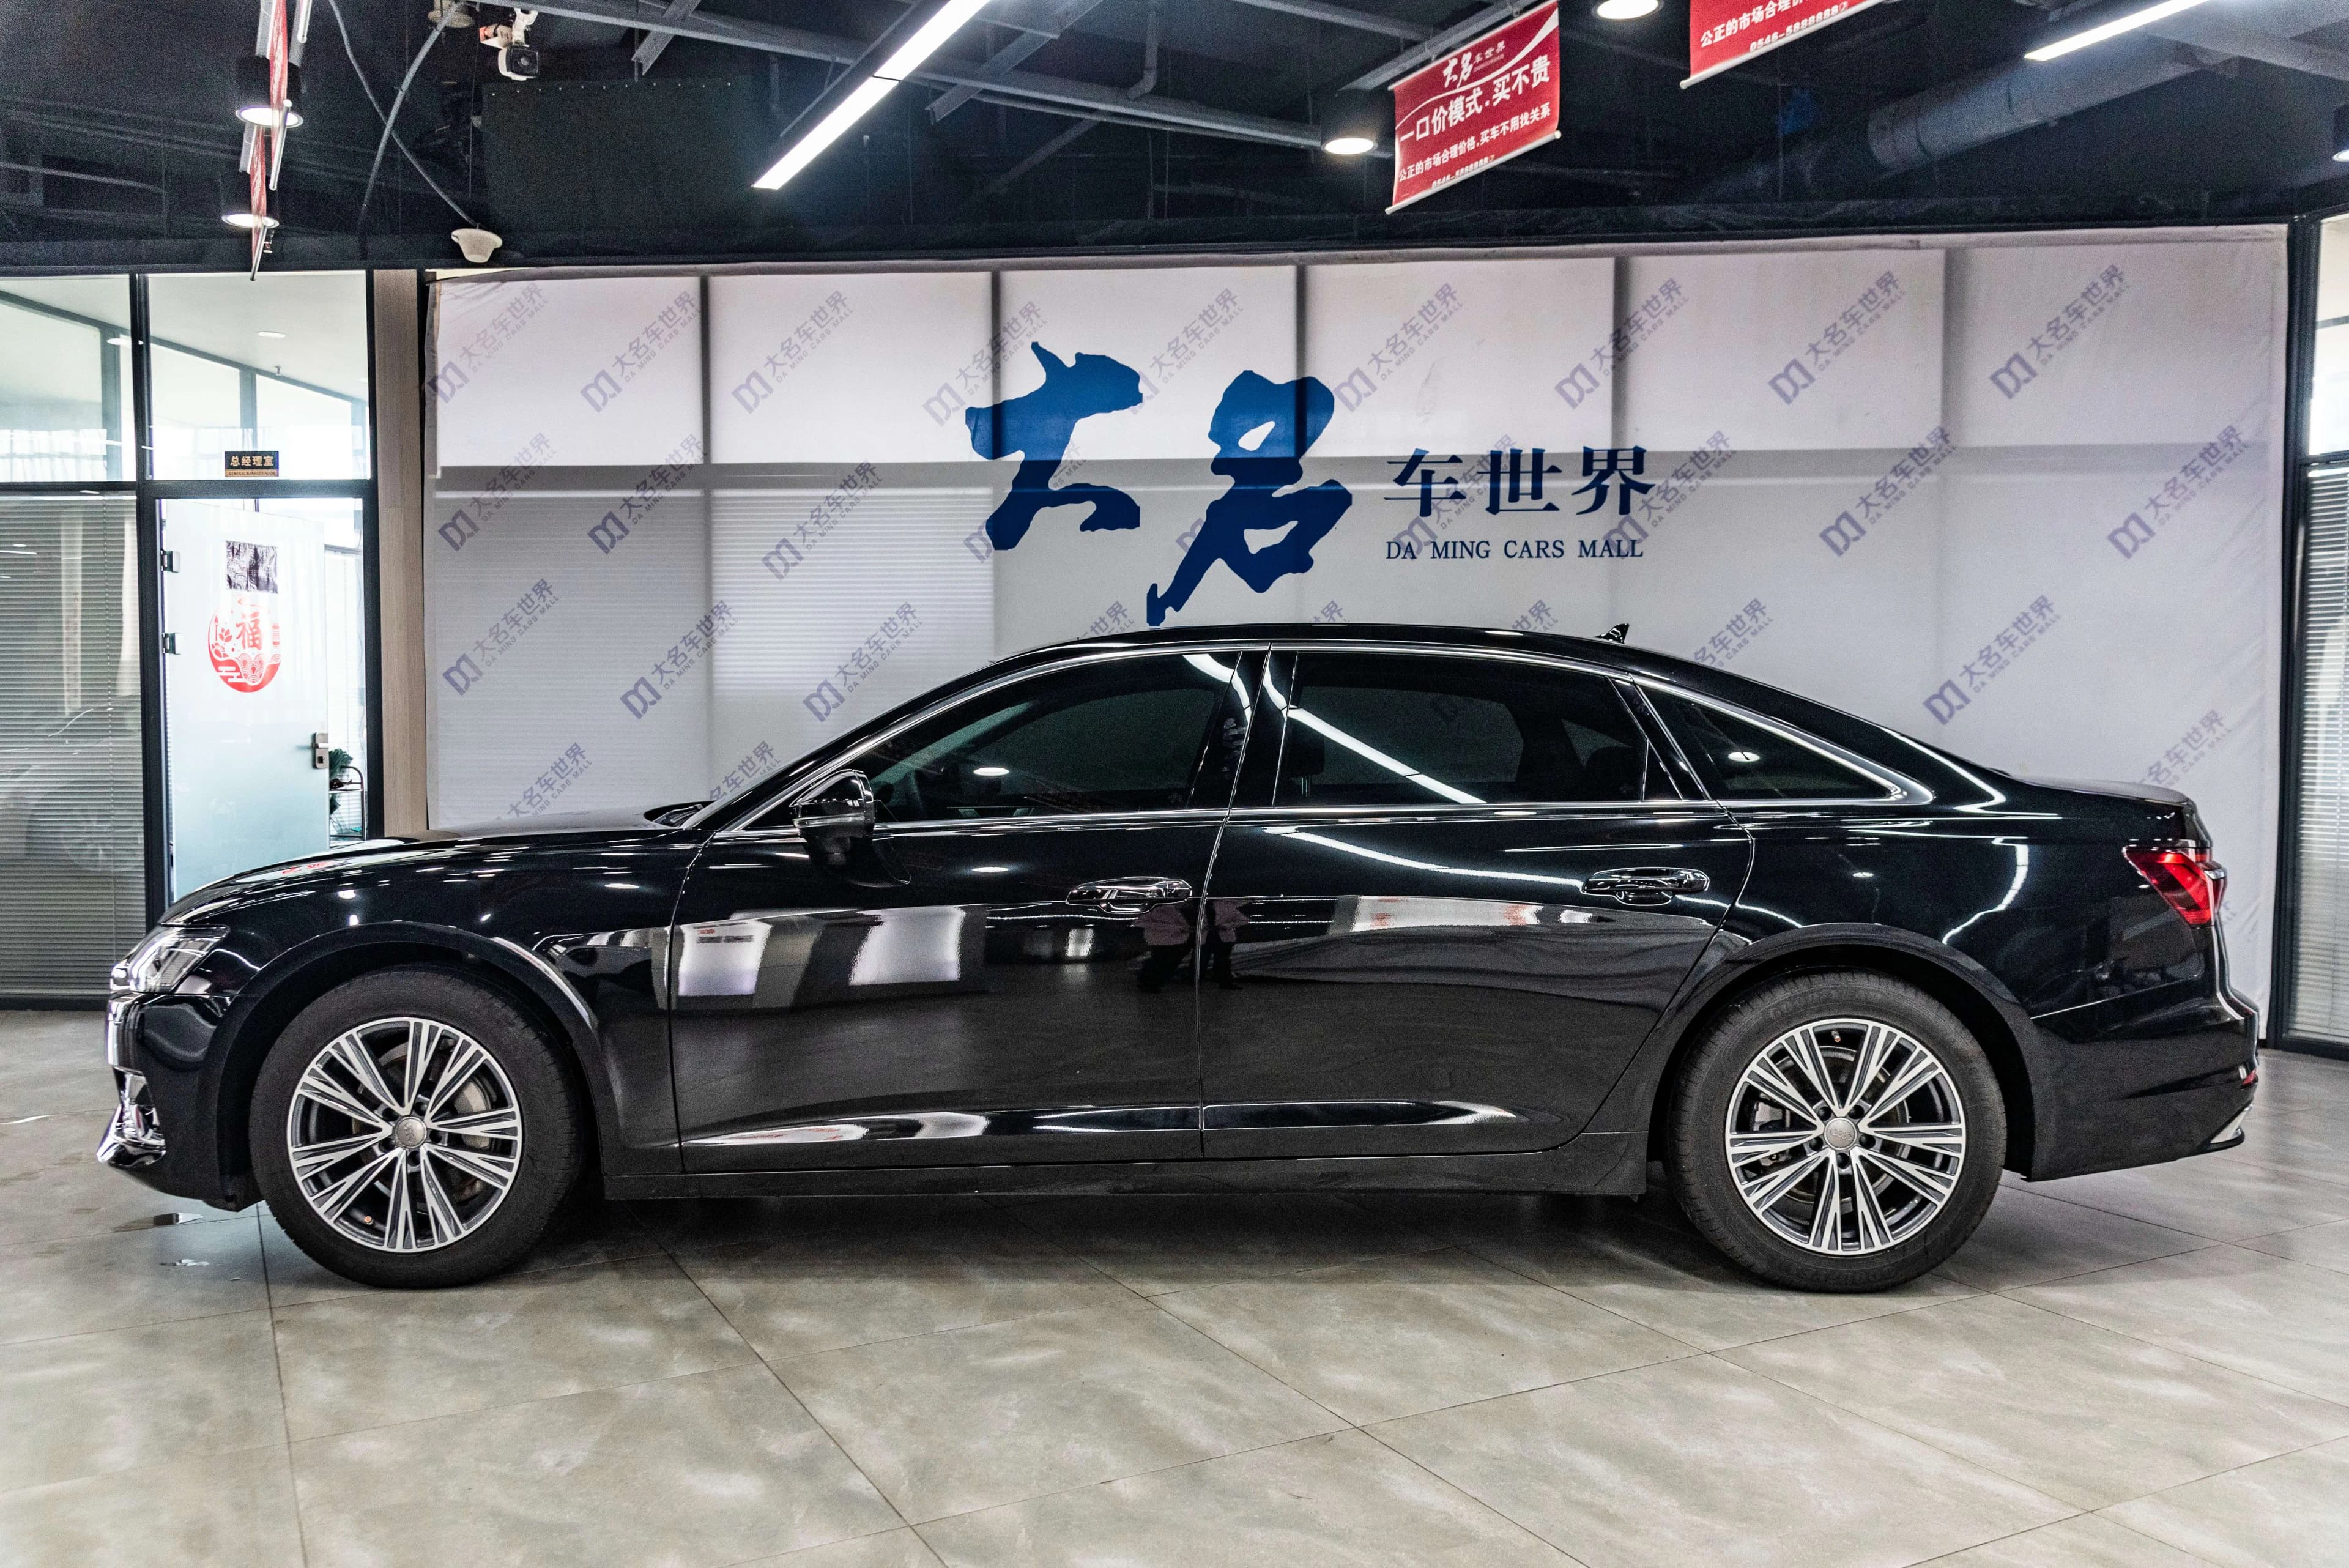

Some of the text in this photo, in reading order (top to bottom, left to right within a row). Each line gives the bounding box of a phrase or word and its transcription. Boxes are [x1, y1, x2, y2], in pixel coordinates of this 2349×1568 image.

[460, 283, 543, 367] 大名车世界
[612, 291, 695, 377] 大名车世界
[764, 290, 847, 377] 大名车世界
[956, 302, 1040, 390] 大名车世界
[1150, 288, 1237, 378] 大名车世界
[1368, 283, 1457, 375] 大名车世界
[1590, 278, 1681, 371] 大名车世界
[1805, 270, 1898, 365] 大名车世界
[2027, 264, 2123, 360] 大名车世界
[230, 455, 273, 466] 总经理室
[620, 434, 703, 519] 大名车世界
[793, 461, 876, 545] 大名车世界
[1384, 448, 1655, 517] 车世界
[1639, 431, 1730, 521] 大名车世界
[1855, 427, 1950, 519] 大名车世界
[2145, 425, 2242, 519] 大名车世界
[1386, 540, 1643, 559] DA MING CARS MALL
[235, 611, 262, 650] 福
[473, 578, 552, 661] 大名车世界
[651, 600, 732, 685] 大名车世界
[835, 602, 916, 687] 大名车世界
[1116, 619, 1134, 633] ALL
[1538, 618, 1558, 632] ALL
[1959, 595, 2053, 687] 大名车世界
